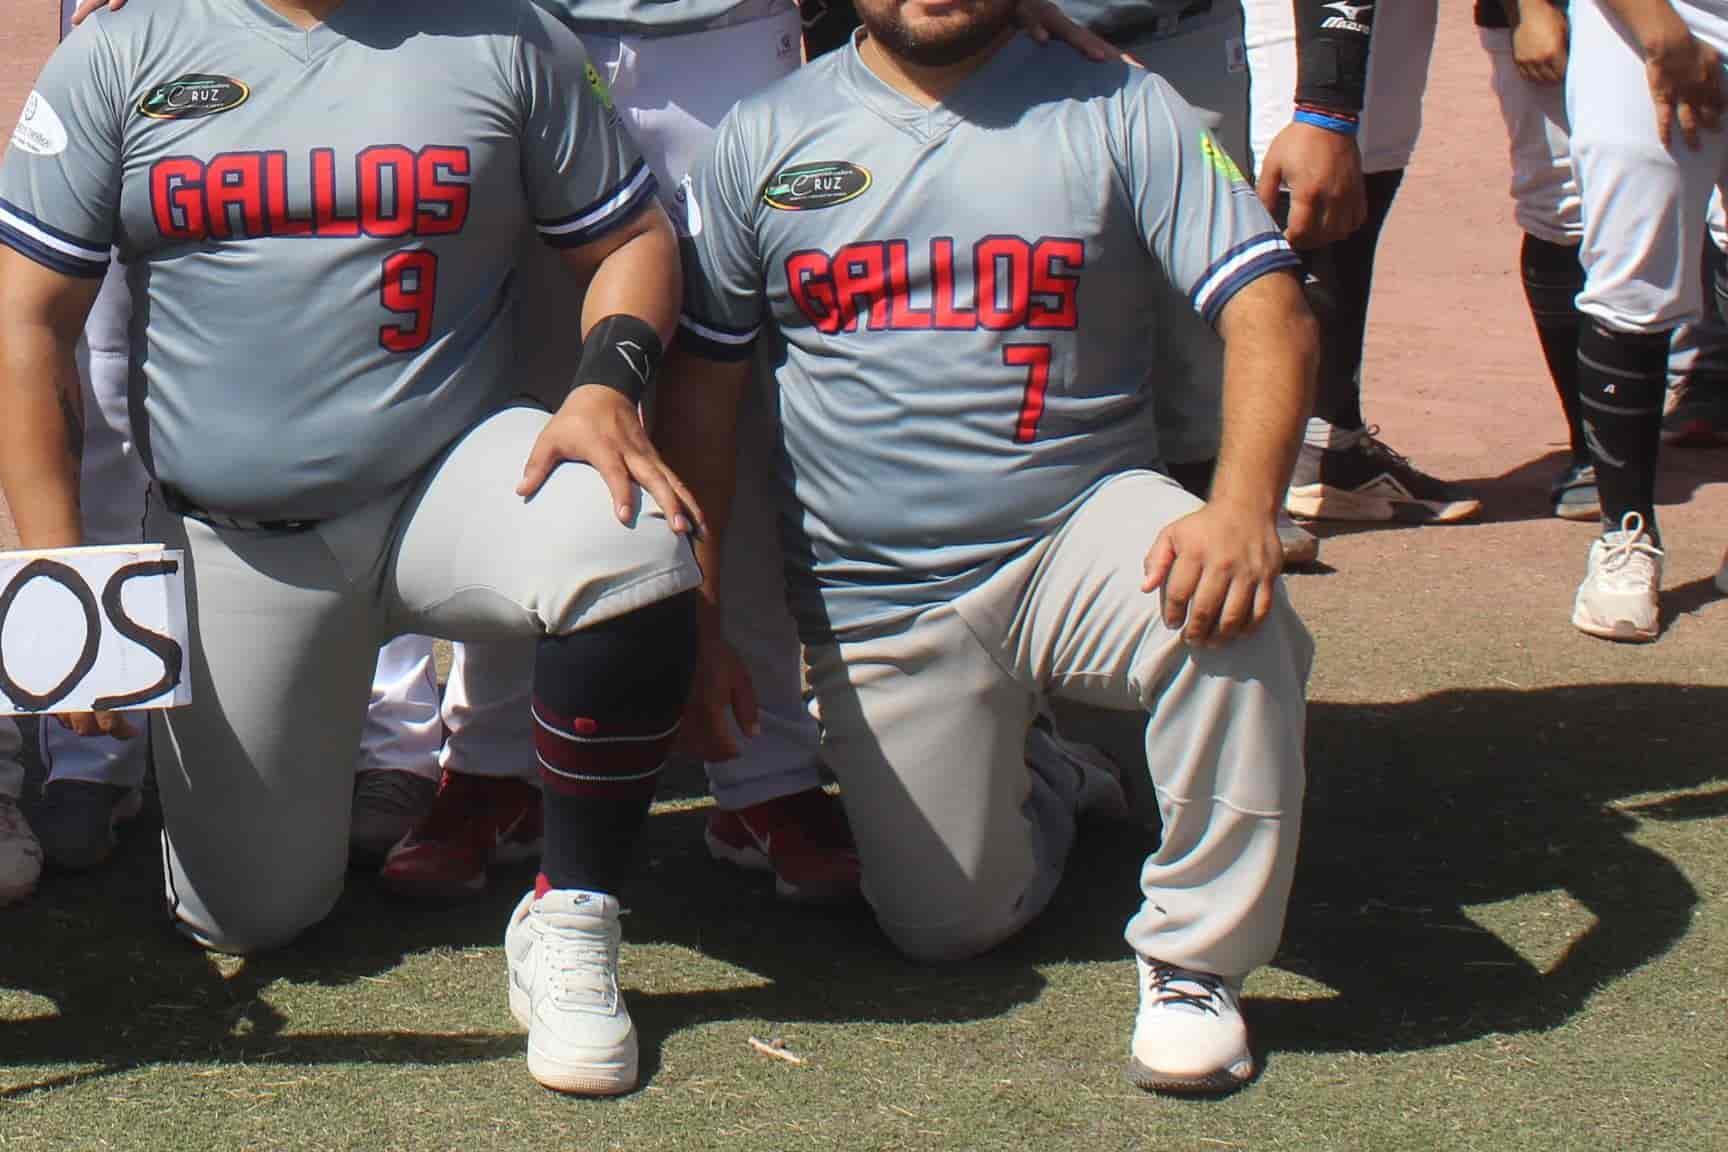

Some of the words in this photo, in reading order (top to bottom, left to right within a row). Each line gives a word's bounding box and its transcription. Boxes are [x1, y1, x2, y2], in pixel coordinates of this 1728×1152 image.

[149, 144, 472, 240] GALLOS
[379, 249, 438, 353] 9
[785, 234, 1085, 335] GALLOS
[1003, 343, 1052, 444] 7
